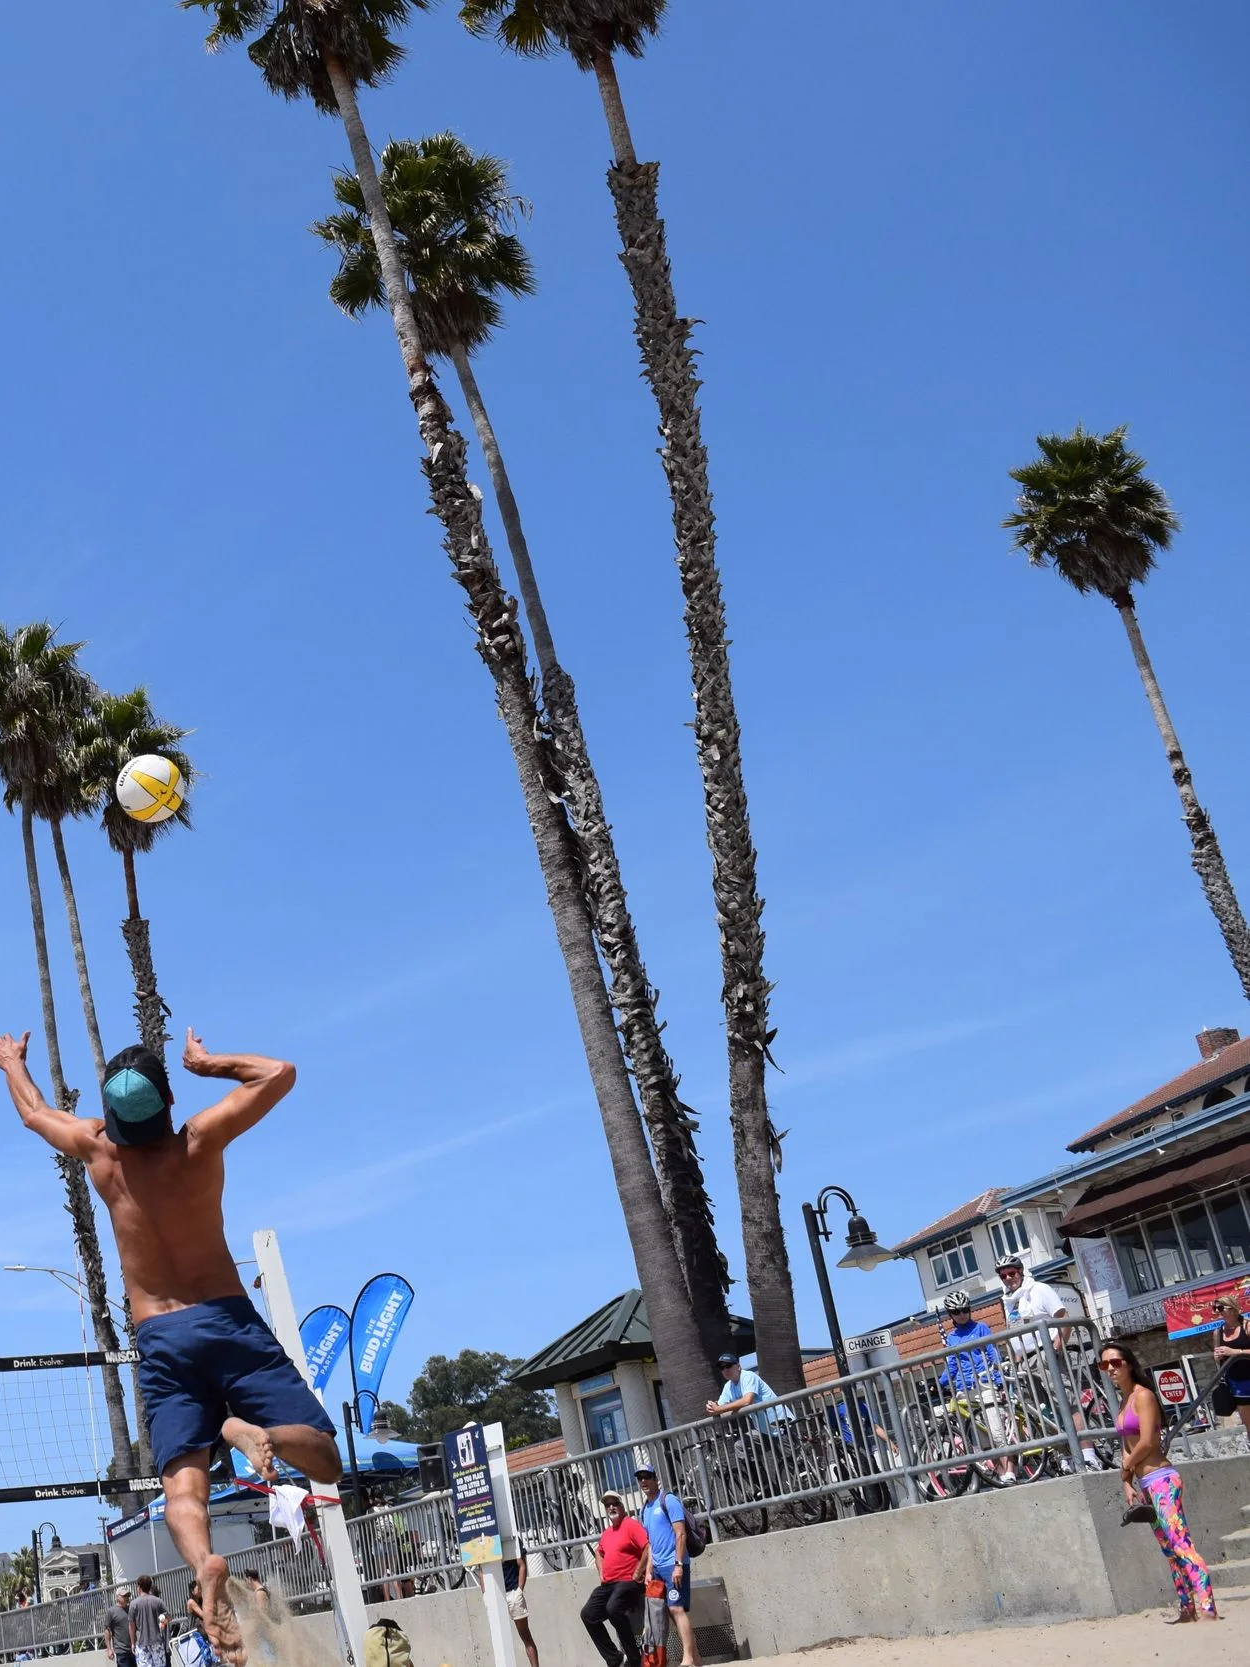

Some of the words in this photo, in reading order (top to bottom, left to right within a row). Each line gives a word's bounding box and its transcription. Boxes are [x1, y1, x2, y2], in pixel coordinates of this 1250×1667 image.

[360, 1337, 381, 1374] BUD
[372, 1289, 404, 1338] LIGHT
[366, 1318, 376, 1334] THE
[382, 1321, 398, 1348] PARTY
[311, 1320, 344, 1363] LIGHT
[848, 1335, 886, 1351] CHANGE
[320, 1350, 335, 1375] PARTY
[129, 1477, 162, 1491] MUSCL
